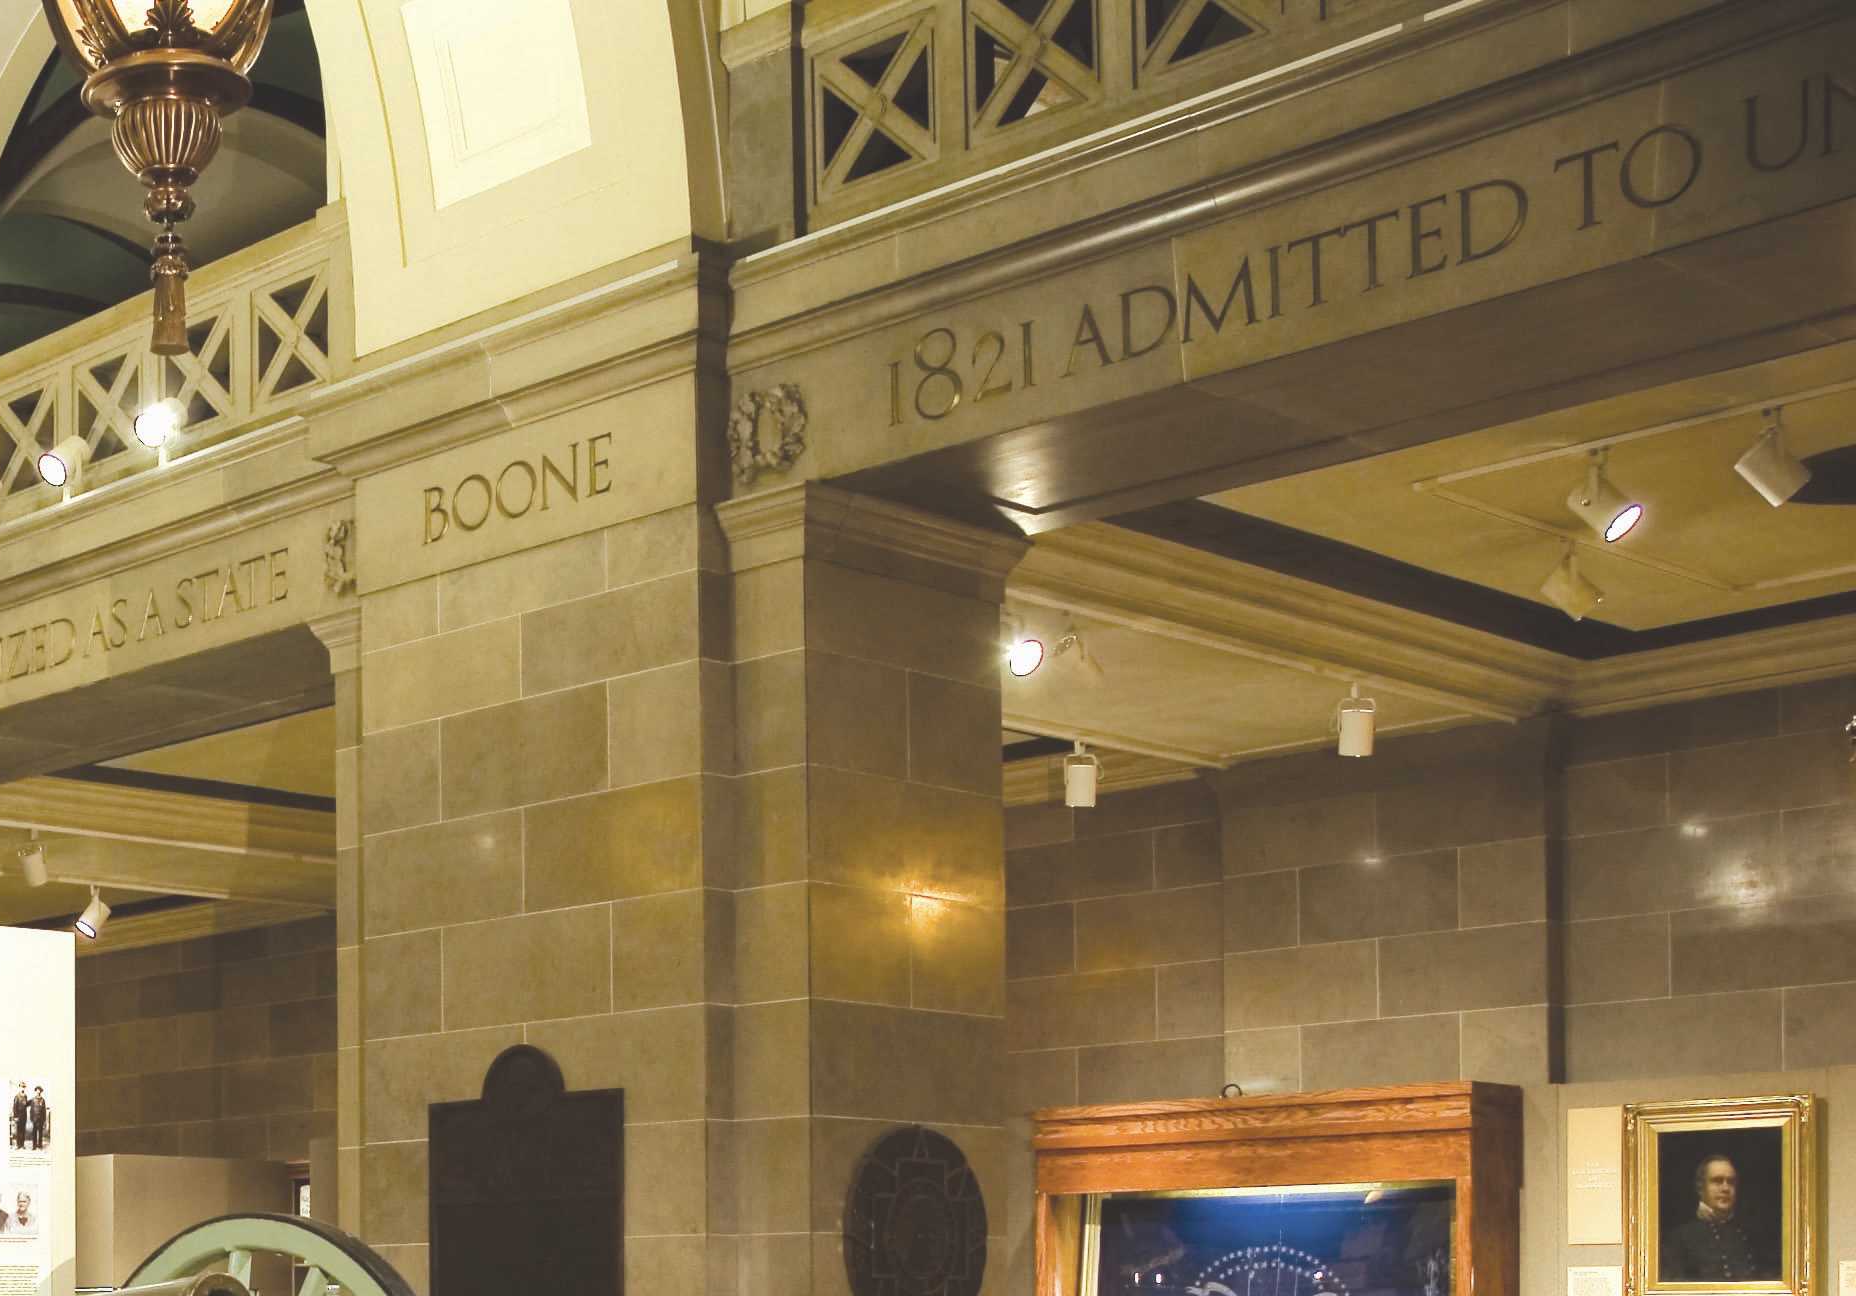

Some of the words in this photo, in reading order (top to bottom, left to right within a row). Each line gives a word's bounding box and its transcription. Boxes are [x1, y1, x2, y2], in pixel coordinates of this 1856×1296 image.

[886, 320, 1039, 428] 1821
[1060, 178, 1530, 380] ADMITTED
[1553, 121, 1704, 232] TO
[422, 431, 614, 545] BOONE
[82, 597, 128, 658] AS
[137, 586, 167, 642] A
[173, 546, 290, 630] STATE
